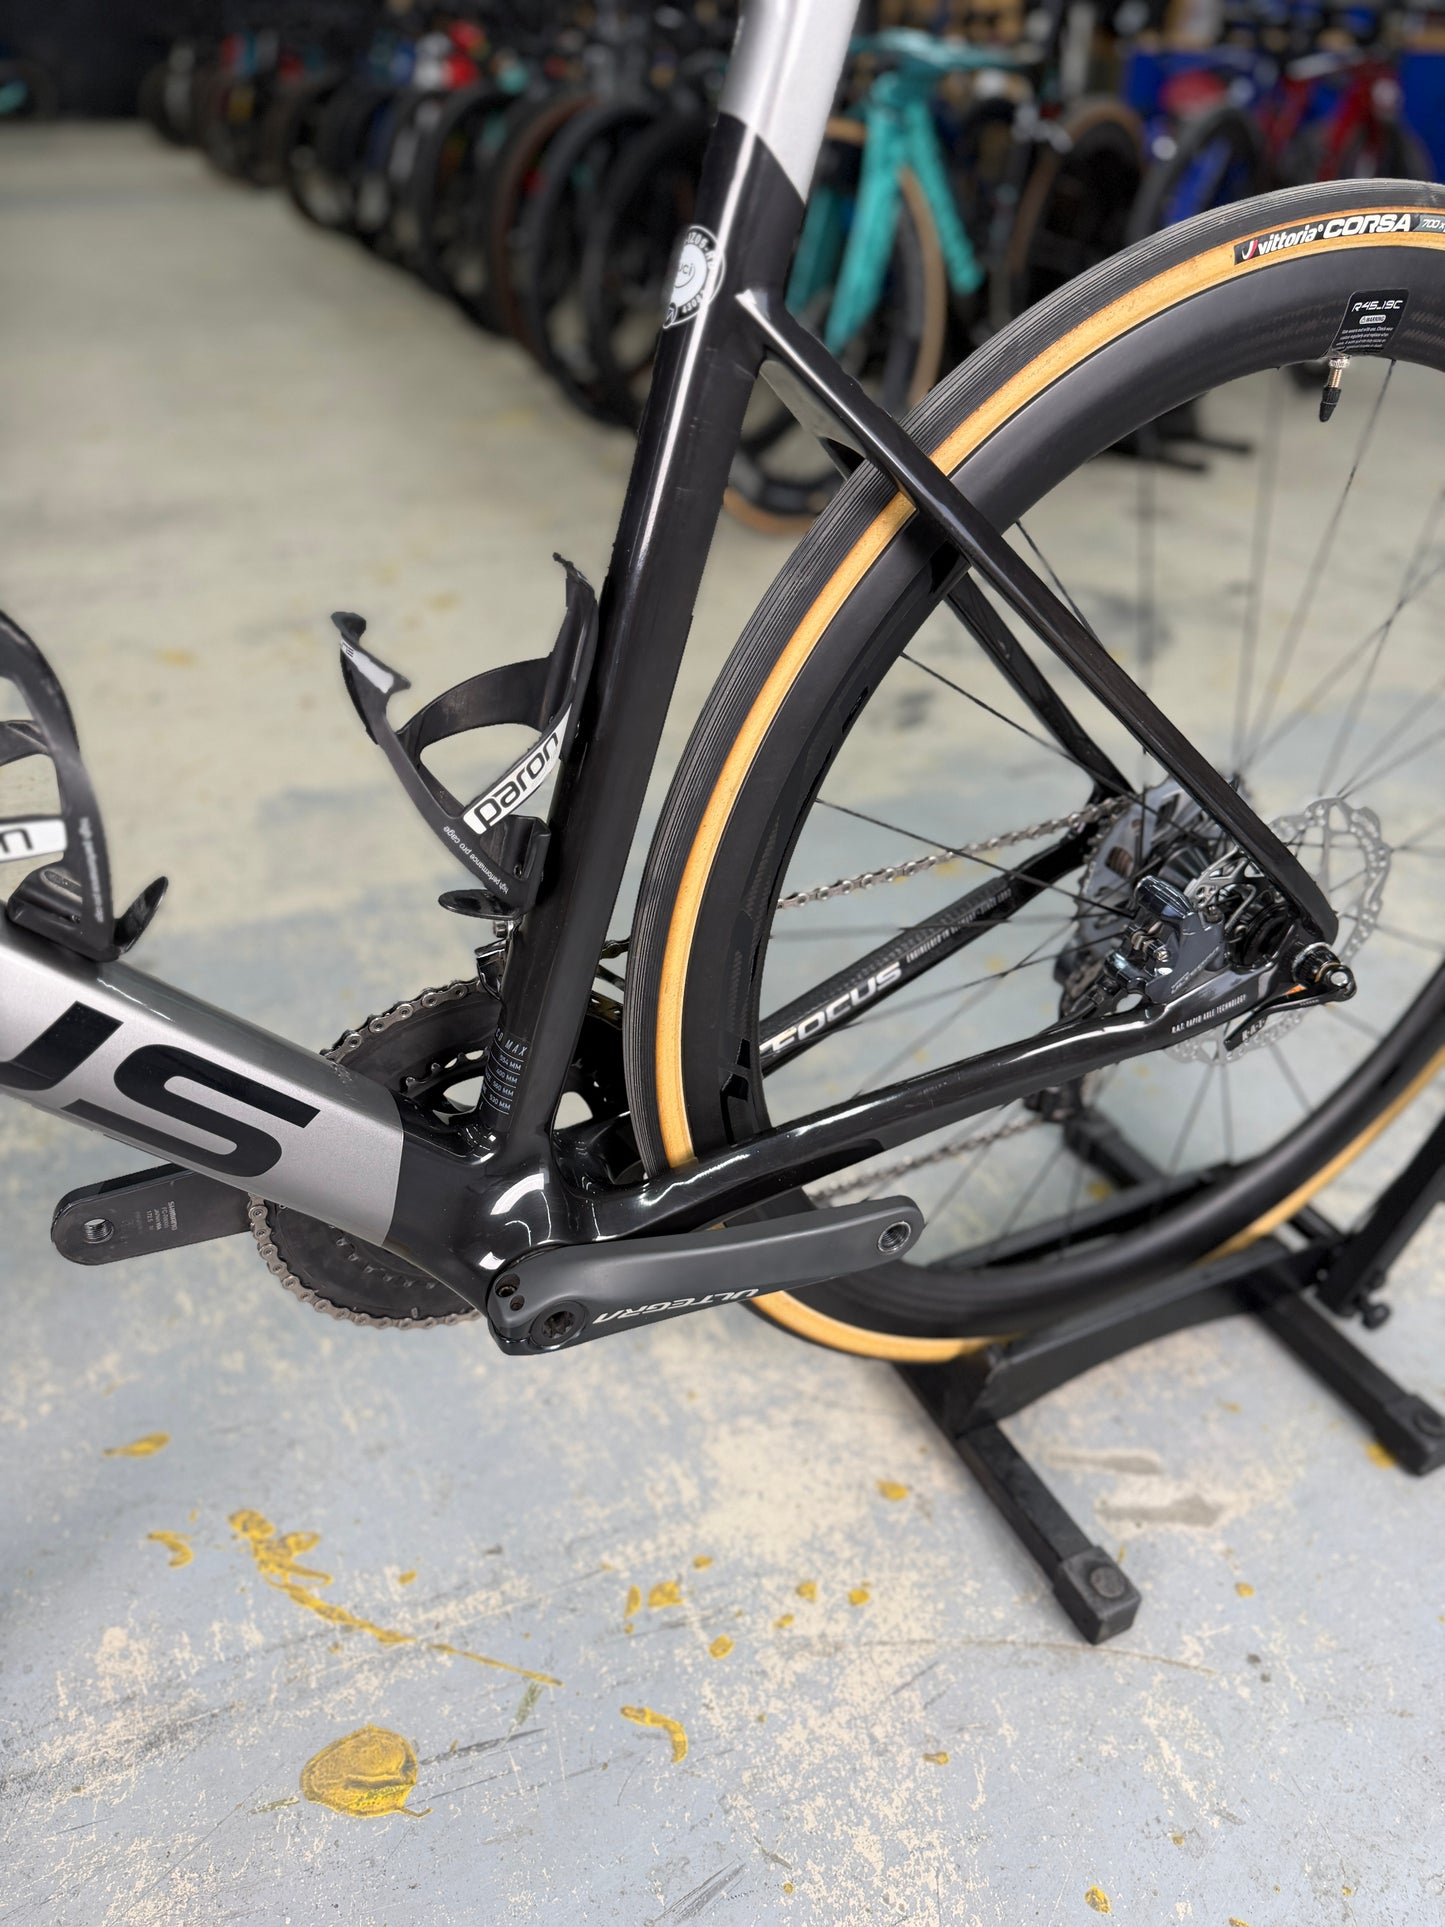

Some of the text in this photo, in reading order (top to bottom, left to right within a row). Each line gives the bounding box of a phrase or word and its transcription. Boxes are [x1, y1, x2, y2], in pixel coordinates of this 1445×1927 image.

[1323, 213, 1411, 239] CORSA
[1366, 315, 1385, 323] WARNING
[473, 732, 559, 830] paron
[443, 825, 509, 895] high performance pro cage
[1216, 994, 1247, 1018] TECHNOLOGY
[504, 1039, 528, 1057] MAX
[509, 1061, 522, 1071] MM
[506, 1074, 518, 1084] MM
[502, 1087, 514, 1097] MM
[499, 1101, 511, 1110] MM
[167, 1200, 178, 1231] SHIMANO
[593, 1288, 759, 1325] ULTEGRA
